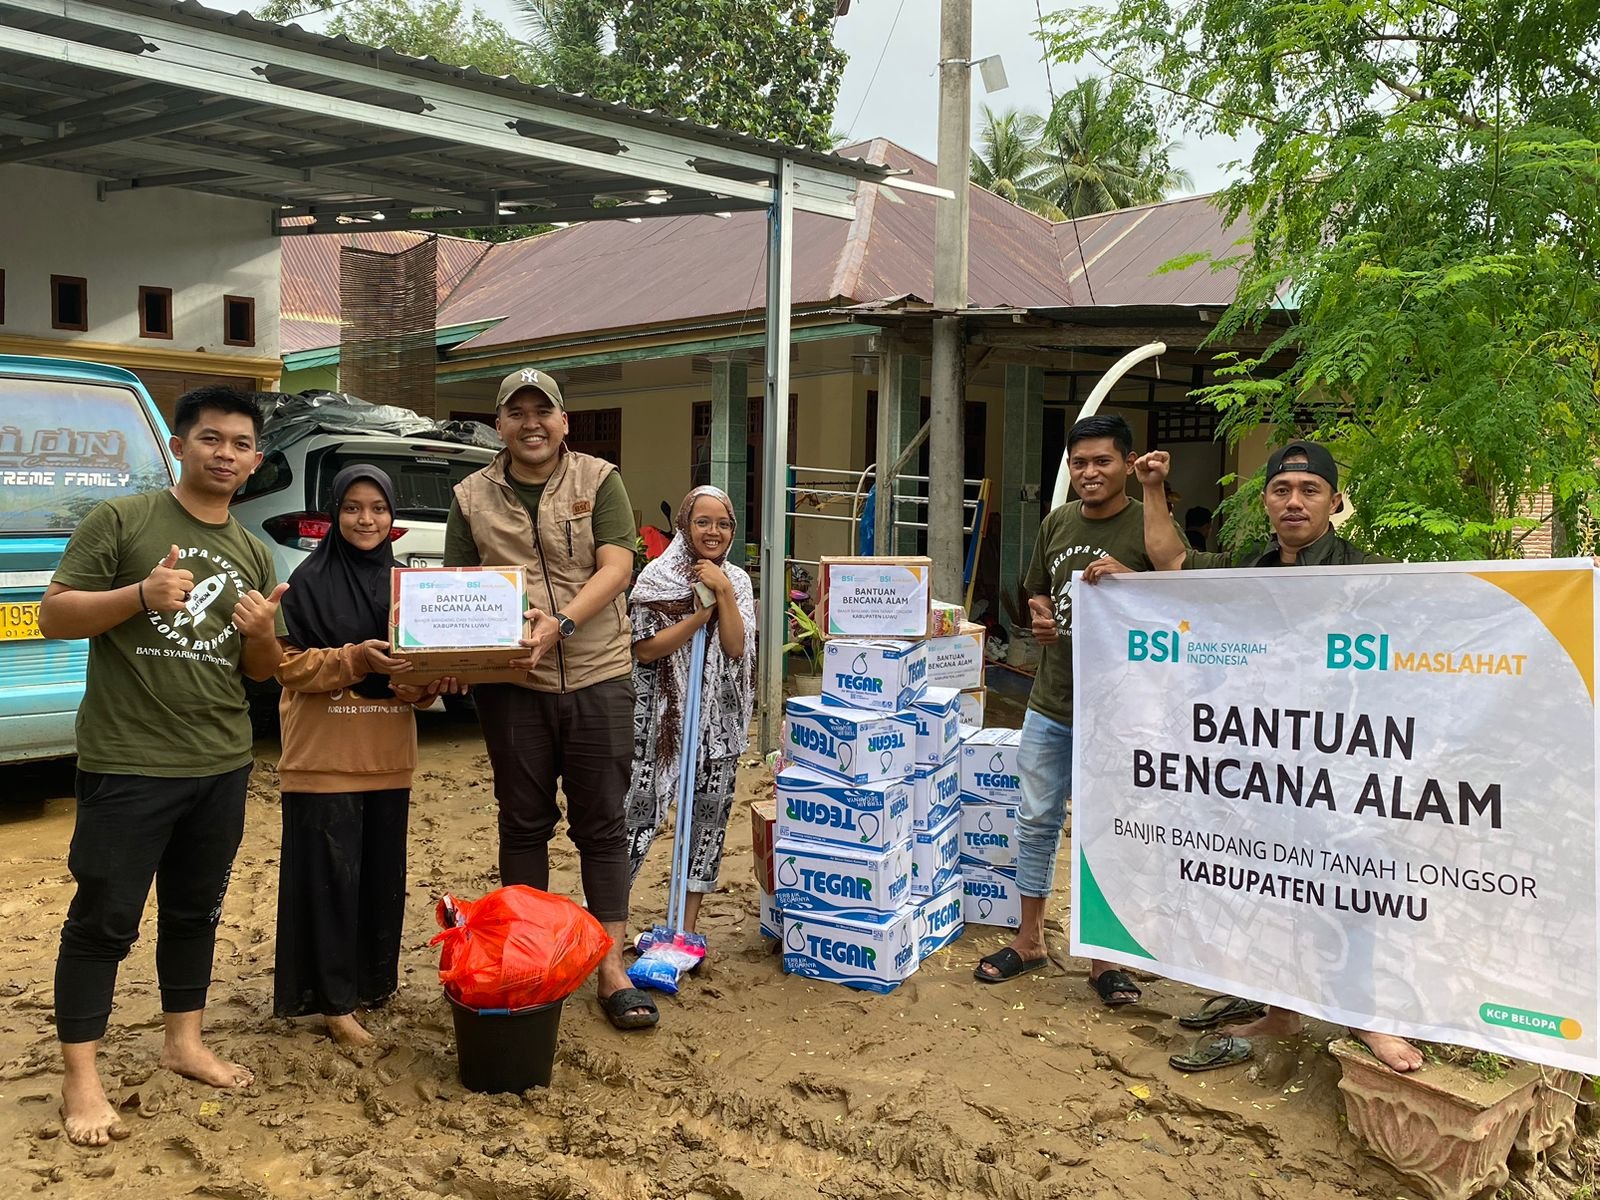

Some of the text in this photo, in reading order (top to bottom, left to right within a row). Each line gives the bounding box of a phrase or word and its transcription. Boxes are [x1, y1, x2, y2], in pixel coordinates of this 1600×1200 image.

[0, 471, 55, 485] REME
[436, 595, 487, 603] BANTUAN
[842, 596, 883, 604] BENCANA
[855, 588, 896, 596] BANTUAN
[421, 603, 503, 612] BENCANA ALAM
[148, 608, 239, 651] LOPA BANGKI
[135, 647, 161, 656] BANK
[163, 649, 200, 661] SYARIAH
[937, 653, 965, 661] BANTUAN
[1128, 629, 1267, 663] BSI BANK SYARIAH
[1326, 633, 1527, 676] BSI MASLAHAT
[908, 657, 926, 685] TEGAR
[928, 661, 956, 669] BENCANA
[1187, 654, 1248, 666] INDONESIA
[836, 673, 883, 693] TEGAR
[791, 722, 837, 759] TEGAR
[868, 732, 905, 752] TEGAR
[1193, 703, 1415, 760] BANTUAN
[937, 772, 958, 800] TEGAR
[974, 773, 1020, 789] TEGAR
[1133, 749, 1502, 829] BENCANA ALAM
[786, 797, 856, 831] TEGAR
[941, 832, 958, 867] TEGAR
[964, 832, 1008, 848] TEGAR
[1114, 818, 1538, 899] BANJIR BANDANG DAN TANAH LONGSOR
[800, 868, 873, 901] TEGAR
[888, 873, 908, 900] TEGAR
[963, 881, 1008, 899] TEGAR
[1179, 858, 1428, 922] KABUPATEN LUWU
[928, 899, 960, 934] TEGAR
[807, 934, 877, 971] TEGAR
[894, 942, 913, 971] TEGAR
[1486, 1008, 1557, 1031] KCP BELOPA
